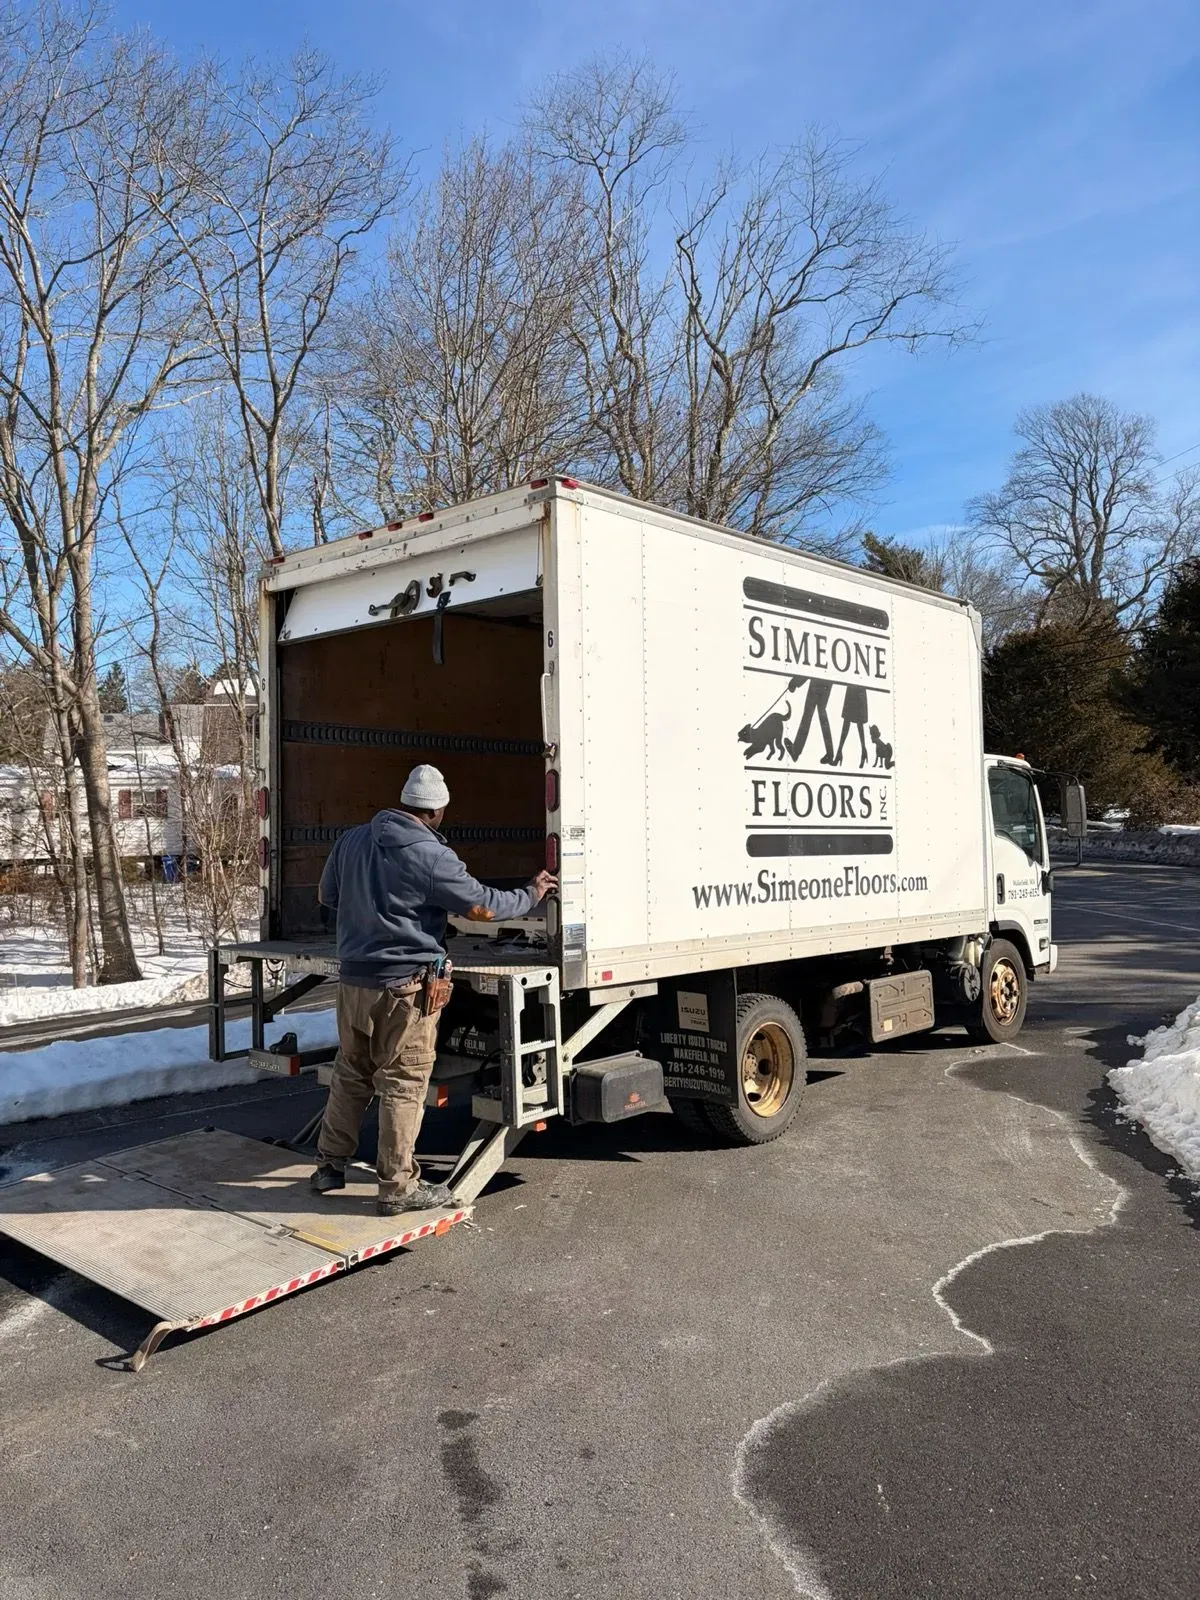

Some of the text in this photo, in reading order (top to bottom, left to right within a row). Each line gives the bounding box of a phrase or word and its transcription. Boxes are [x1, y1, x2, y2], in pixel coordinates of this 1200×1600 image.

[547, 630, 554, 648] 6
[749, 615, 887, 679] SIMEONE
[752, 779, 872, 819] FLOORS
[879, 785, 888, 821] INC.
[692, 866, 928, 909] www.SimeoneFloors.com
[681, 1007, 706, 1016] ISUZU
[660, 1032, 687, 1046] LIBERTY
[706, 1038, 728, 1053] TRUCKS
[667, 1061, 725, 1081] 781-246-1919
[664, 1076, 732, 1095] BERTYISUZUTRUCKS.COM
